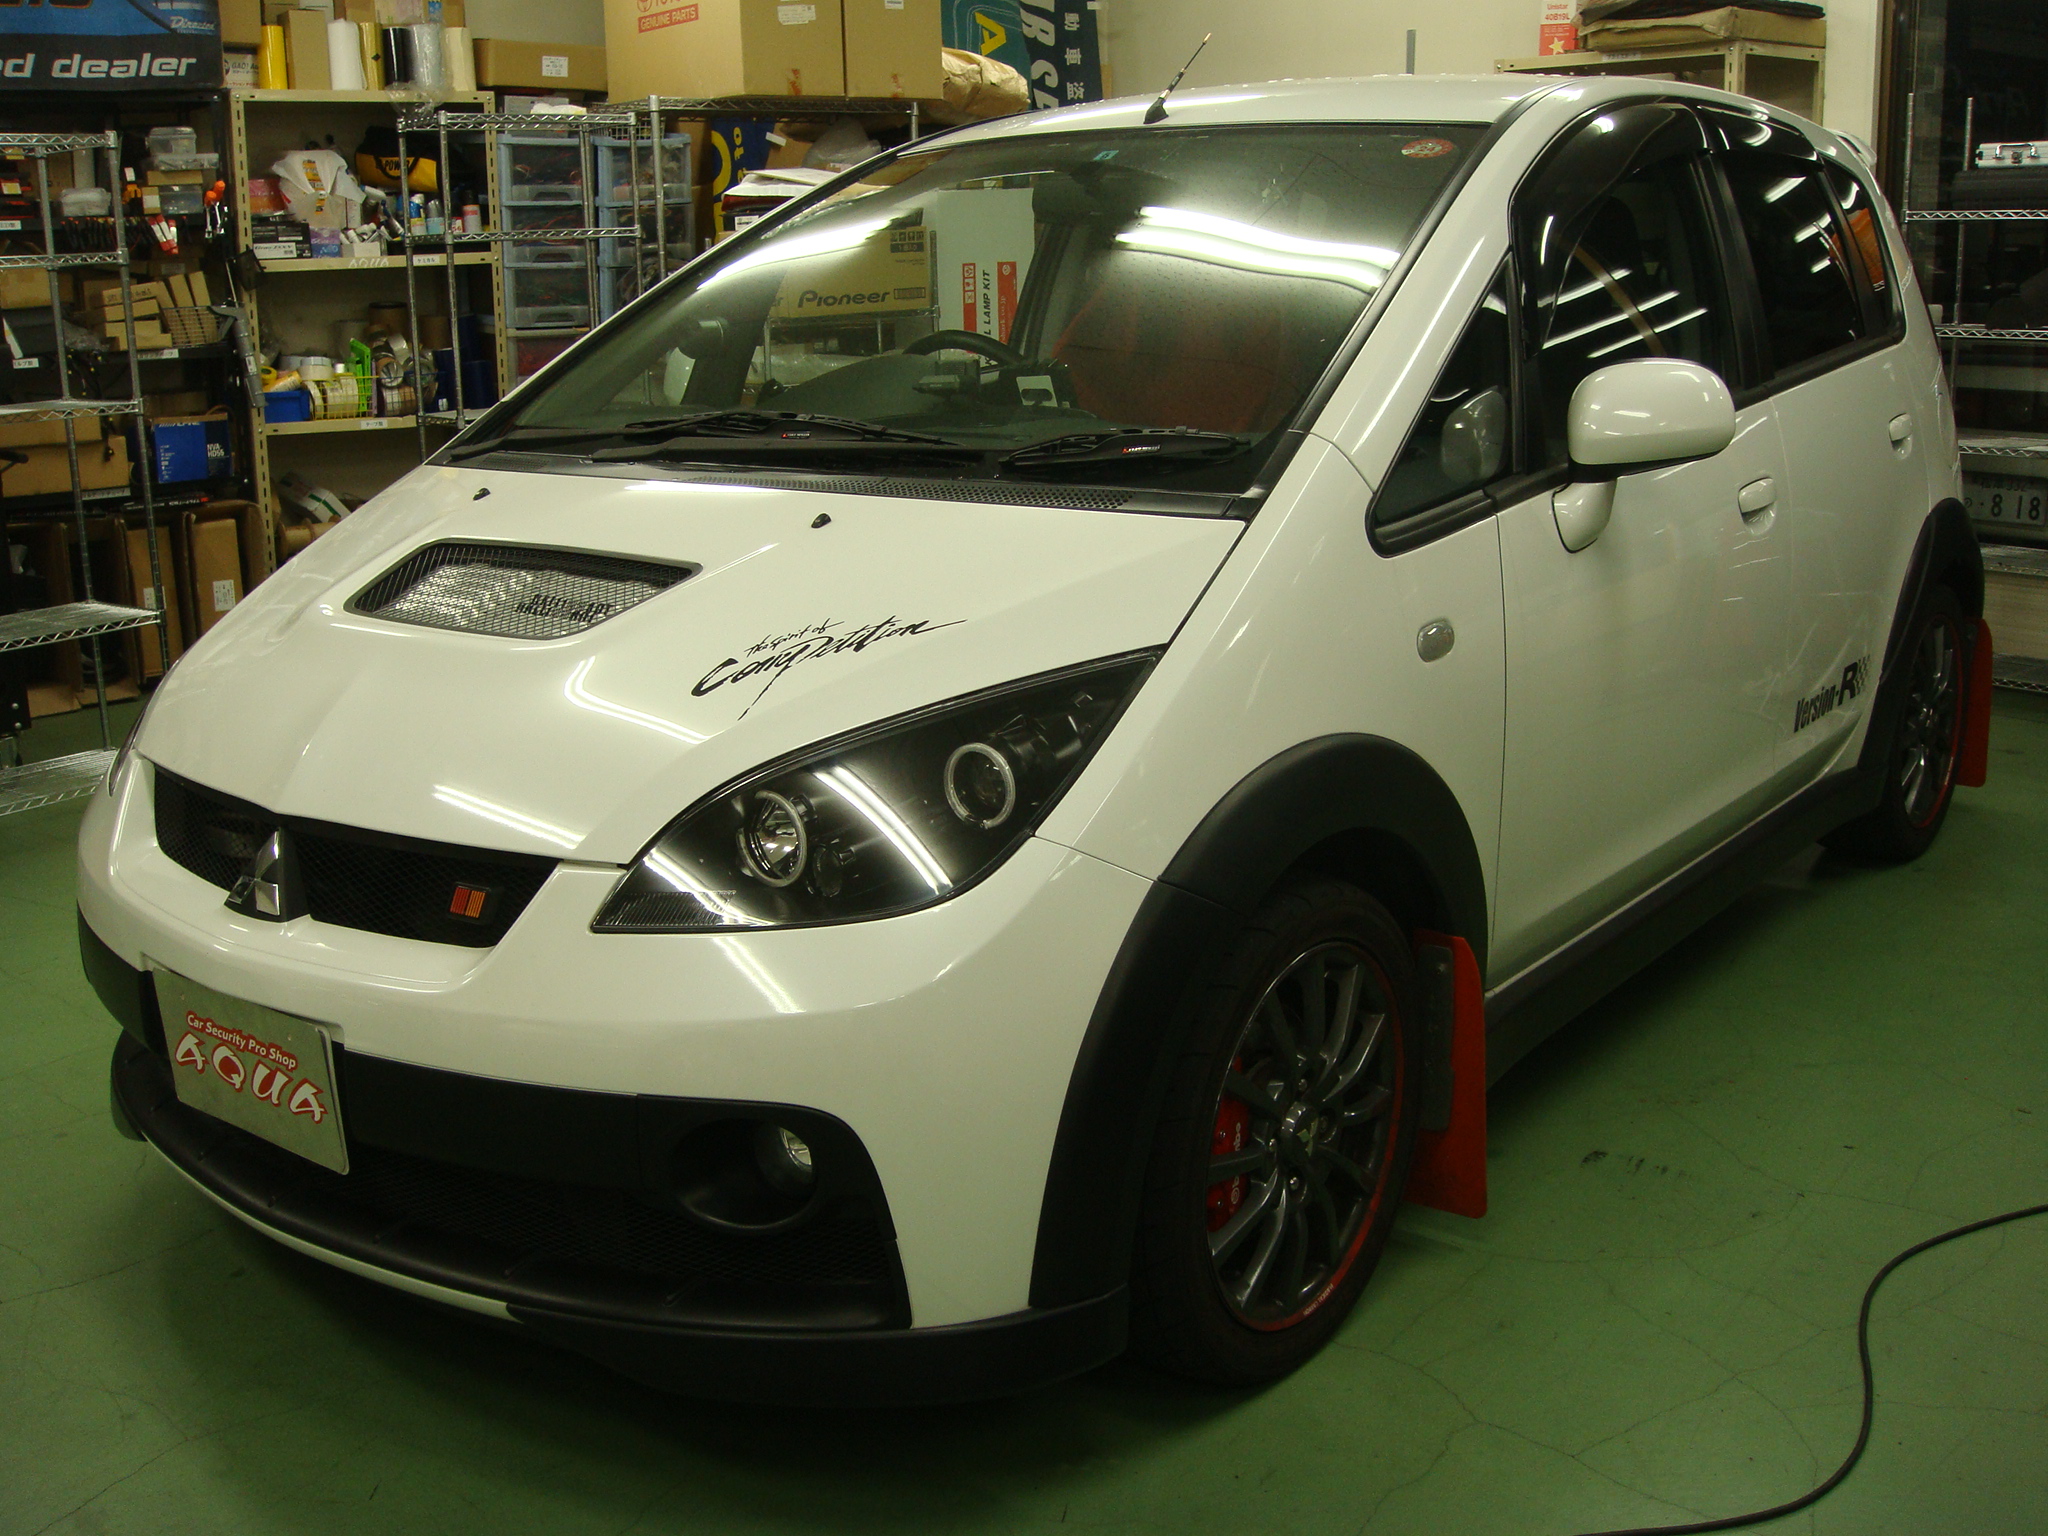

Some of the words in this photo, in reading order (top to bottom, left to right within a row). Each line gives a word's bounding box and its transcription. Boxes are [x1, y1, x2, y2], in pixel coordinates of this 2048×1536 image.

[641, 13, 671, 30] GENUINE
[671, 7, 696, 24] PARTS
[51, 52, 197, 79] dealer
[982, 269, 992, 290] KIT
[797, 289, 890, 309] Pioneer
[982, 293, 992, 326] LAMP
[691, 615, 967, 721] Competition
[187, 1014, 204, 1029] Car
[205, 1022, 247, 1050] Security
[248, 1039, 267, 1056] Pro
[268, 1048, 296, 1070] Shop
[174, 1032, 326, 1122] AQUA
